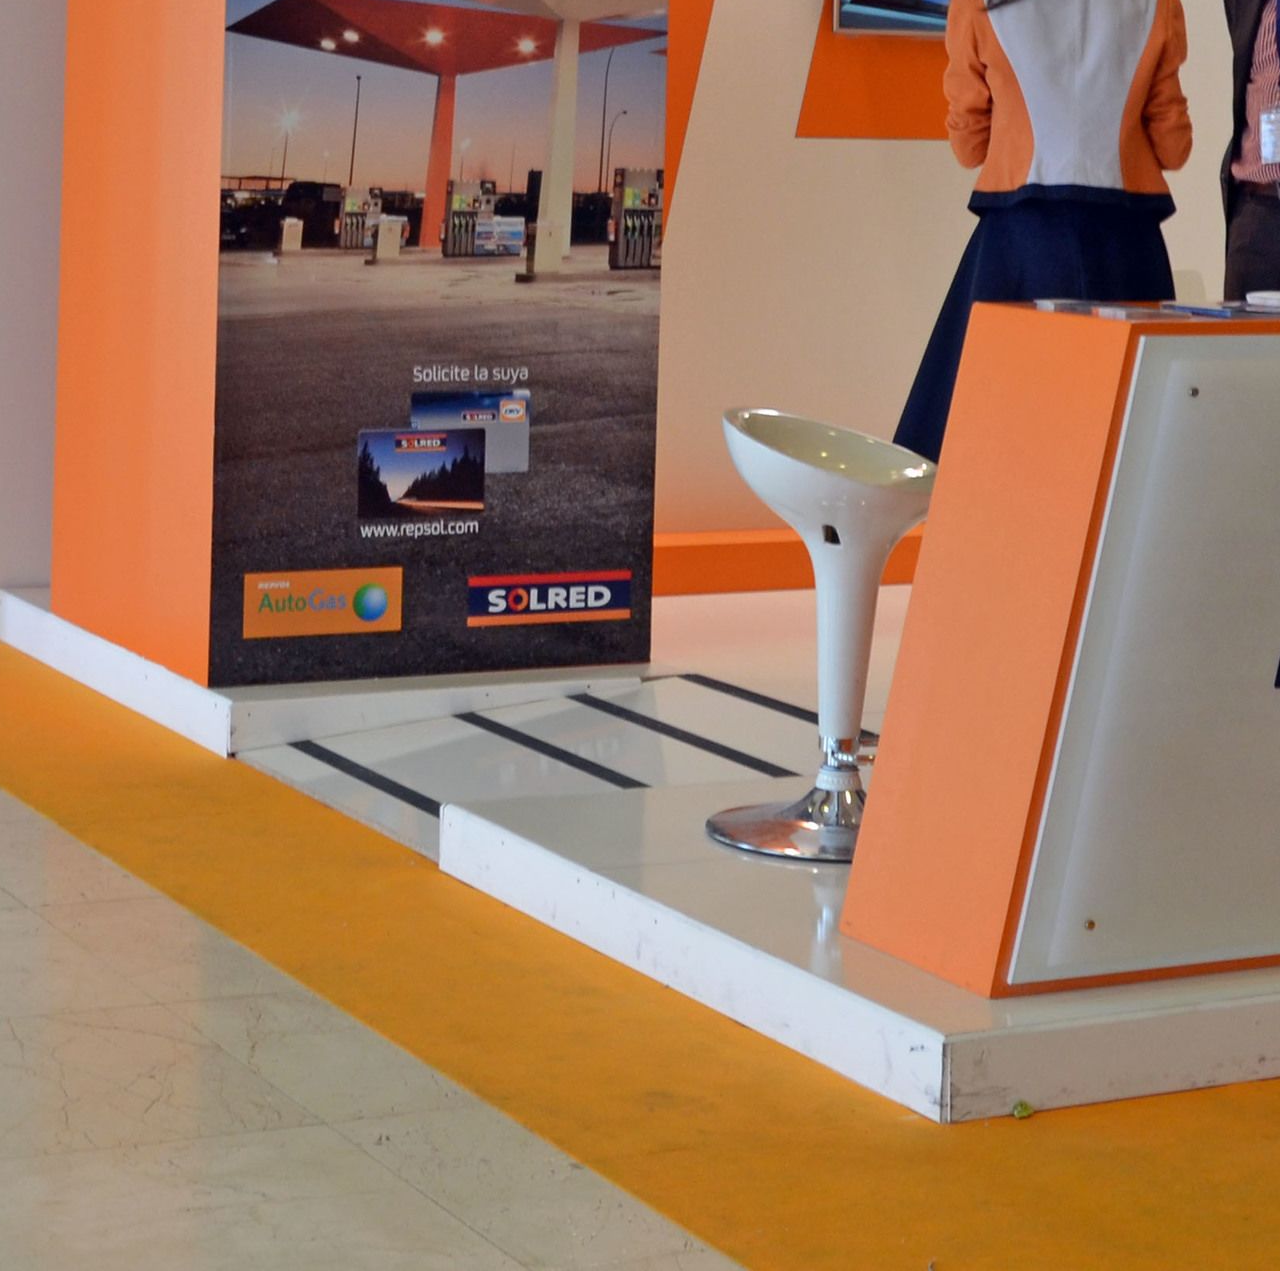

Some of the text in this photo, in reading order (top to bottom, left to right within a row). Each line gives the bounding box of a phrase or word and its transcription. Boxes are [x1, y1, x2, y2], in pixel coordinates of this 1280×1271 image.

[413, 365, 529, 385] Solicite la suya
[401, 438, 441, 448] SOLRED
[360, 519, 479, 539] www.repsol.com
[258, 586, 347, 614] AutoGas
[487, 584, 612, 614] SOLRED
